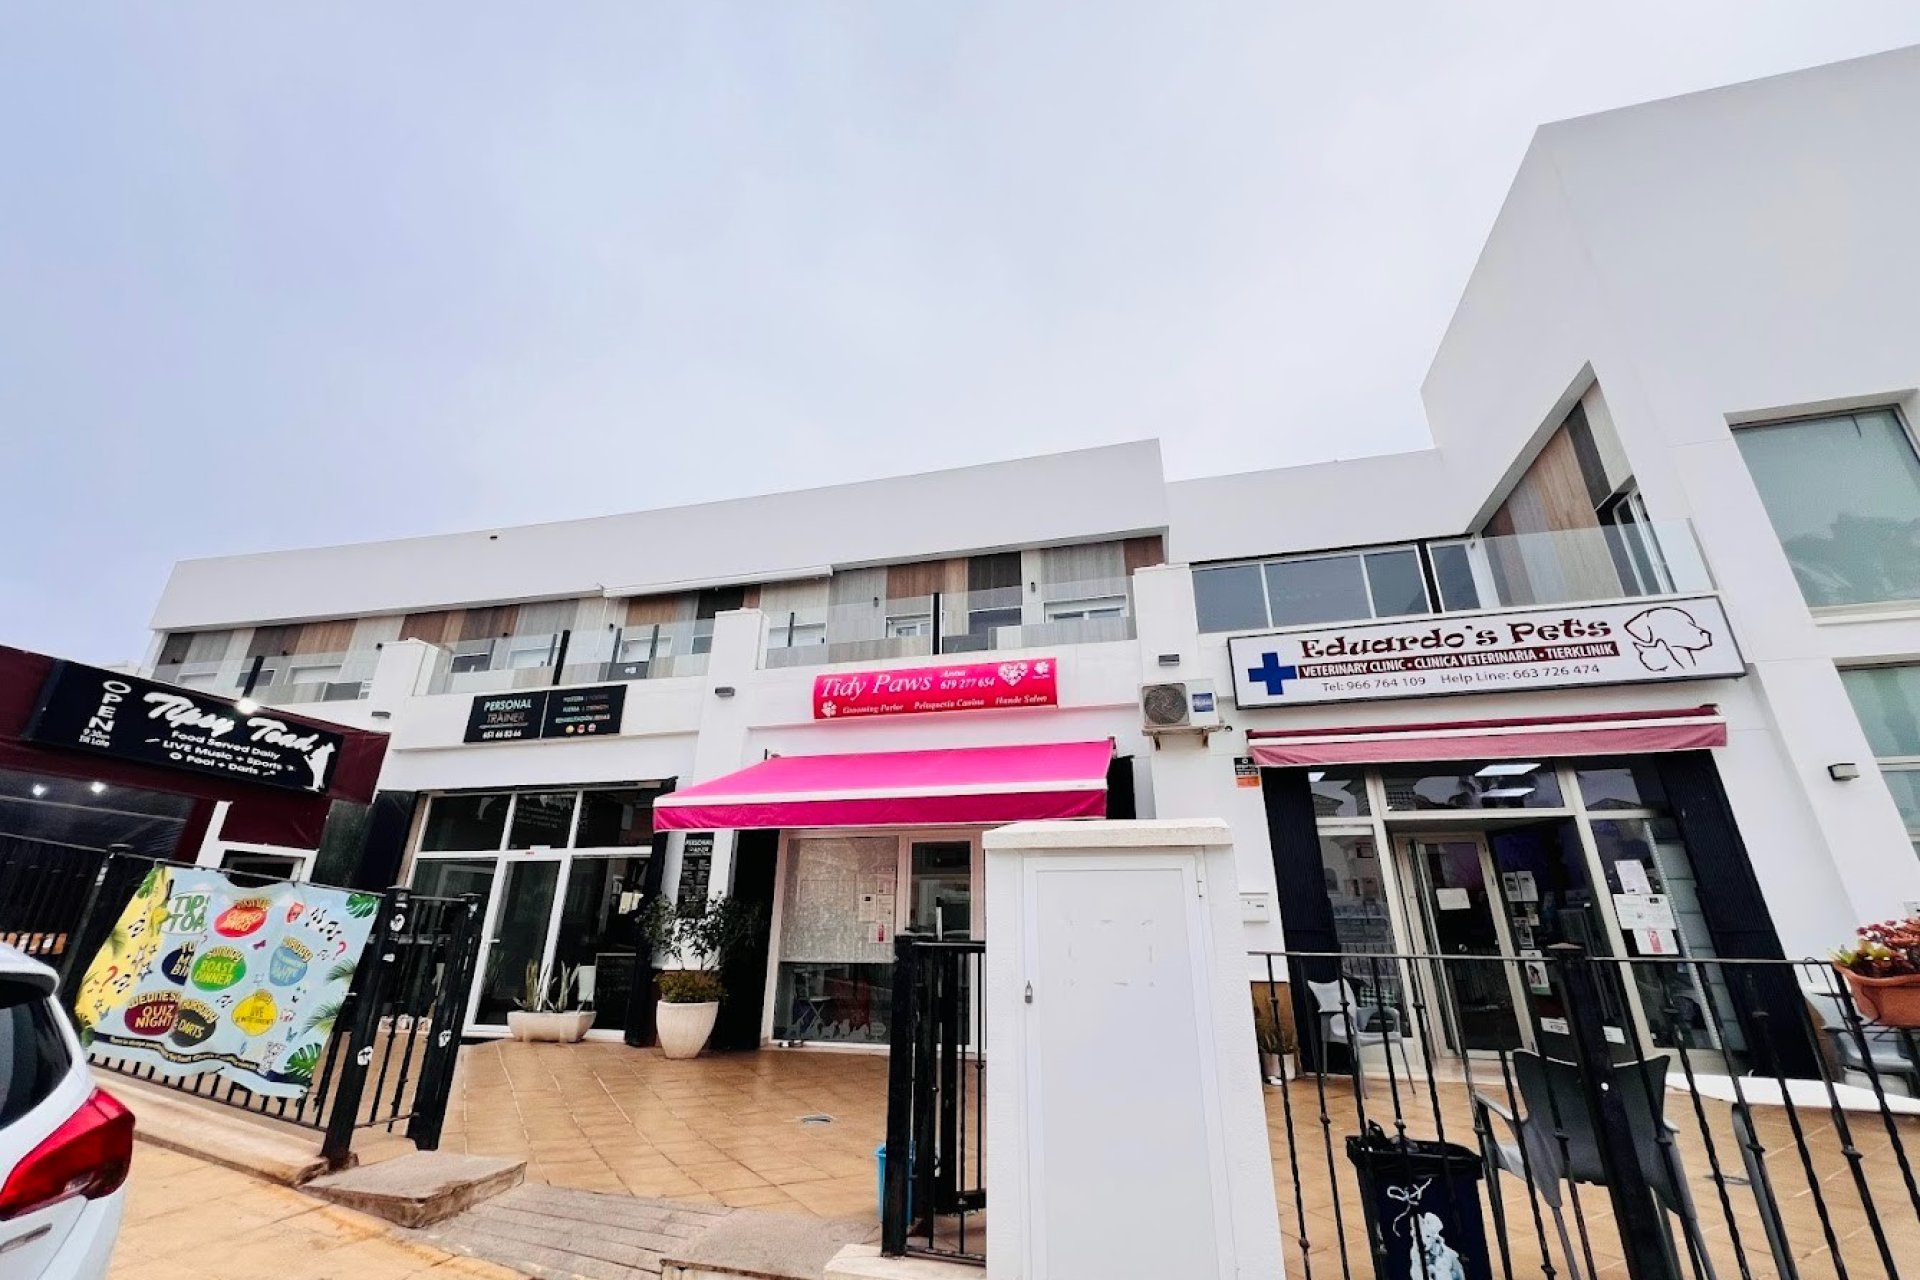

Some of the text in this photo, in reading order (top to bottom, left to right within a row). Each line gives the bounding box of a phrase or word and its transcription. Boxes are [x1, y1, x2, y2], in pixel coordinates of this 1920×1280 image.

[1298, 618, 1611, 658] Eduardo's Pets
[1303, 643, 1614, 677] VETERINARY CLINIC CLINICA VETERINARIA TIERKLINIK
[822, 674, 933, 702] Tidy Paws
[959, 678, 977, 689] 277
[1323, 664, 1600, 693] Tel: 966 764 109 Help Line: 663 726 474
[88, 680, 132, 733] OPEN
[484, 699, 532, 712] PERSONAL
[143, 692, 320, 753] Tipsy Toad
[487, 712, 526, 724] TRAINER
[162, 740, 193, 753] LIVE
[194, 747, 234, 761] Music
[246, 757, 284, 770] Sports
[171, 730, 281, 760] Food Served Daily
[186, 755, 216, 767] Pool
[227, 762, 260, 776] Darts
[194, 970, 234, 987] DINNER
[200, 959, 236, 974] ROAST
[135, 1016, 174, 1029] NIGHT
[142, 1004, 175, 1017] QUIZ
